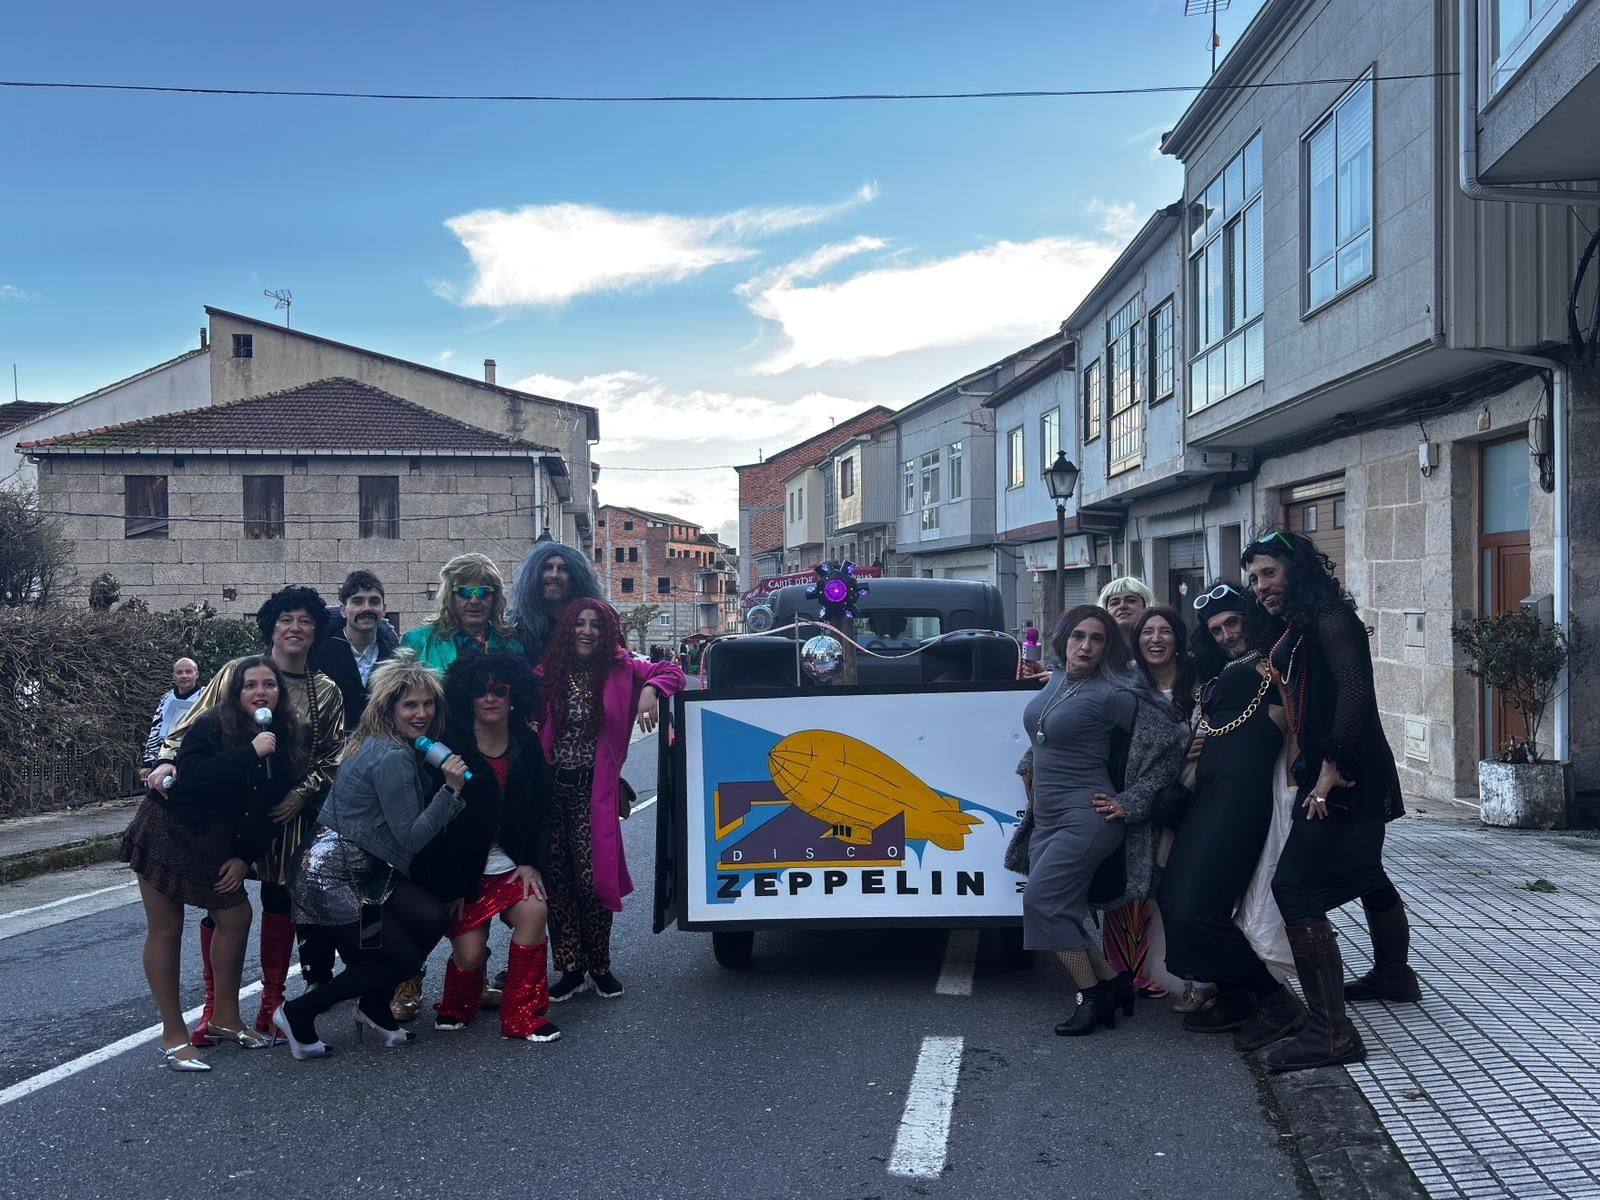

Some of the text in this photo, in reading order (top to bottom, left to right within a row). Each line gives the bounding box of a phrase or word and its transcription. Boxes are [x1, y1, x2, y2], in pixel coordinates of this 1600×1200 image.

[768, 578, 793, 588] CARTE
[732, 846, 898, 861] DISCO
[716, 869, 985, 898] ZEPPELIN
